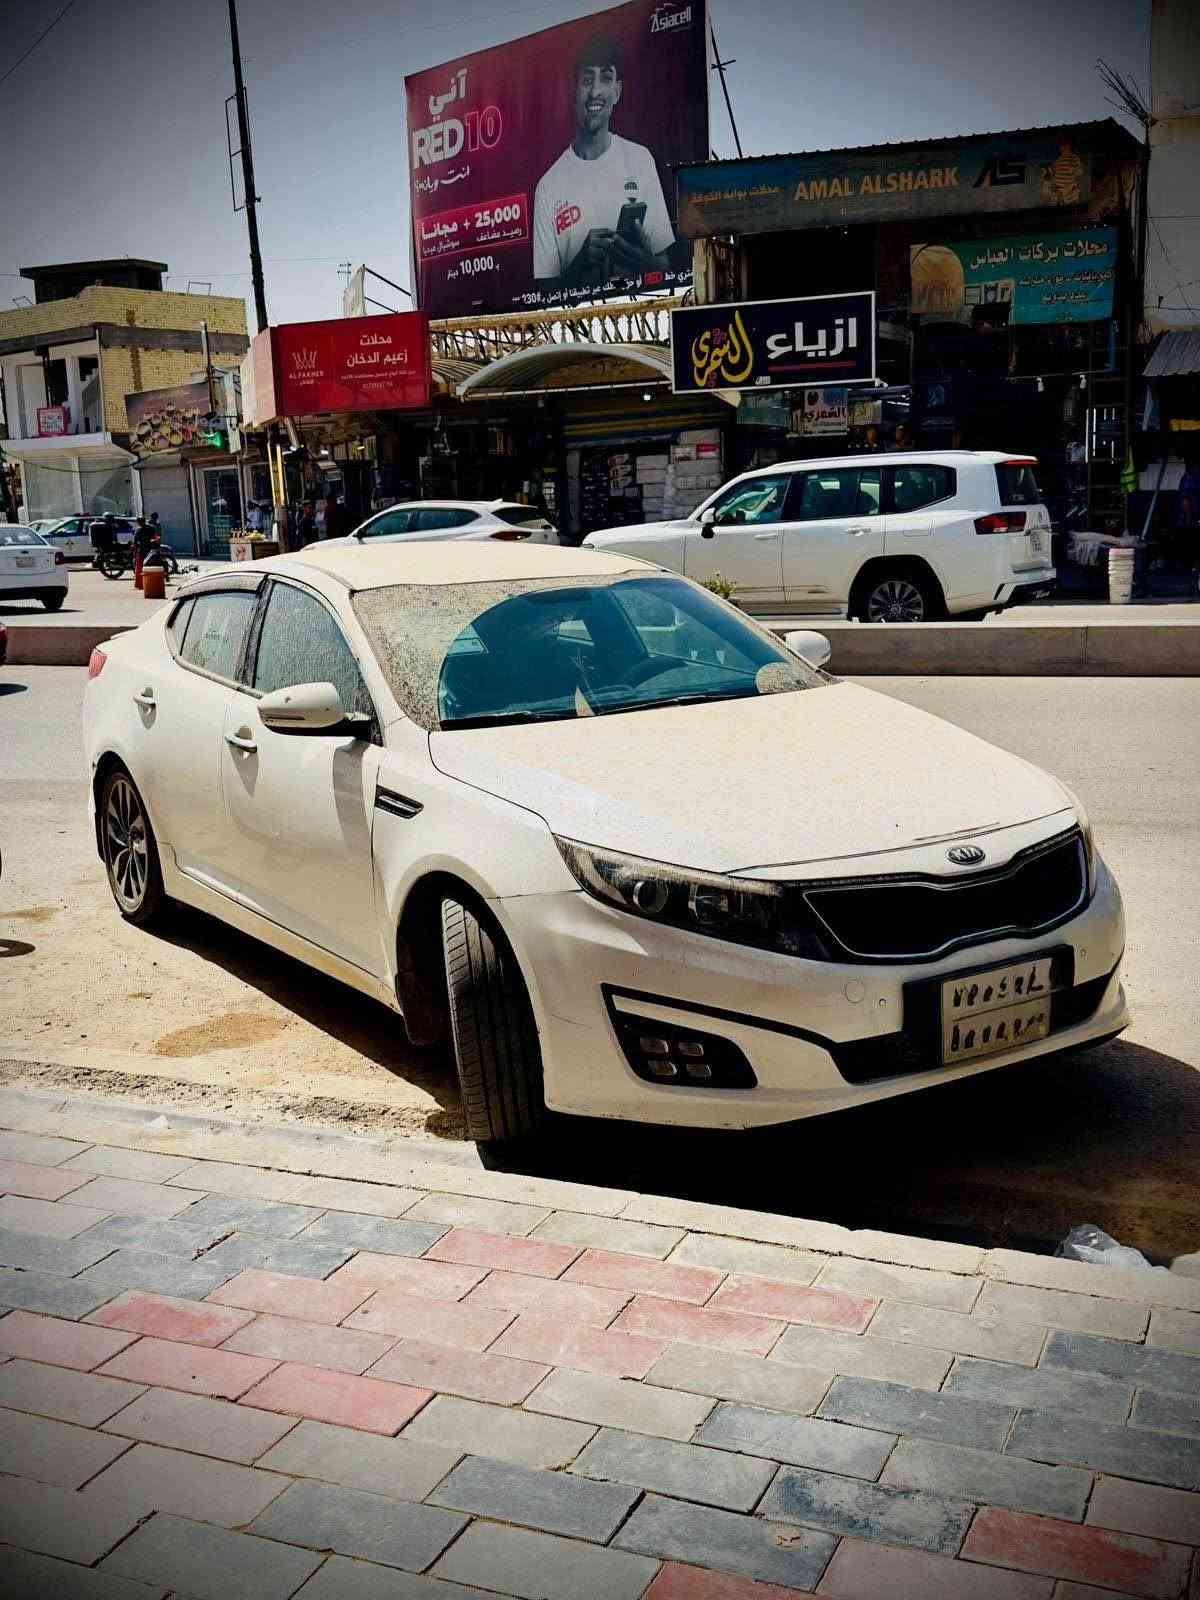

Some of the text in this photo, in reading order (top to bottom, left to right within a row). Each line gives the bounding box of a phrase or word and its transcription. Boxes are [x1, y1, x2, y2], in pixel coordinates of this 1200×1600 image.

[650, 6, 692, 33] Asiacell
[428, 68, 468, 123] آني
[793, 165, 960, 201] AMAL ALSHARK
[474, 203, 521, 229] 25,000
[555, 205, 582, 236] RED
[1018, 242, 1060, 263] بركات
[1063, 239, 1109, 257] محلات
[459, 255, 494, 277] 10,000
[360, 332, 392, 346] محلات
[765, 316, 857, 360] ازياء
[346, 348, 408, 367] زعيم الدخان
